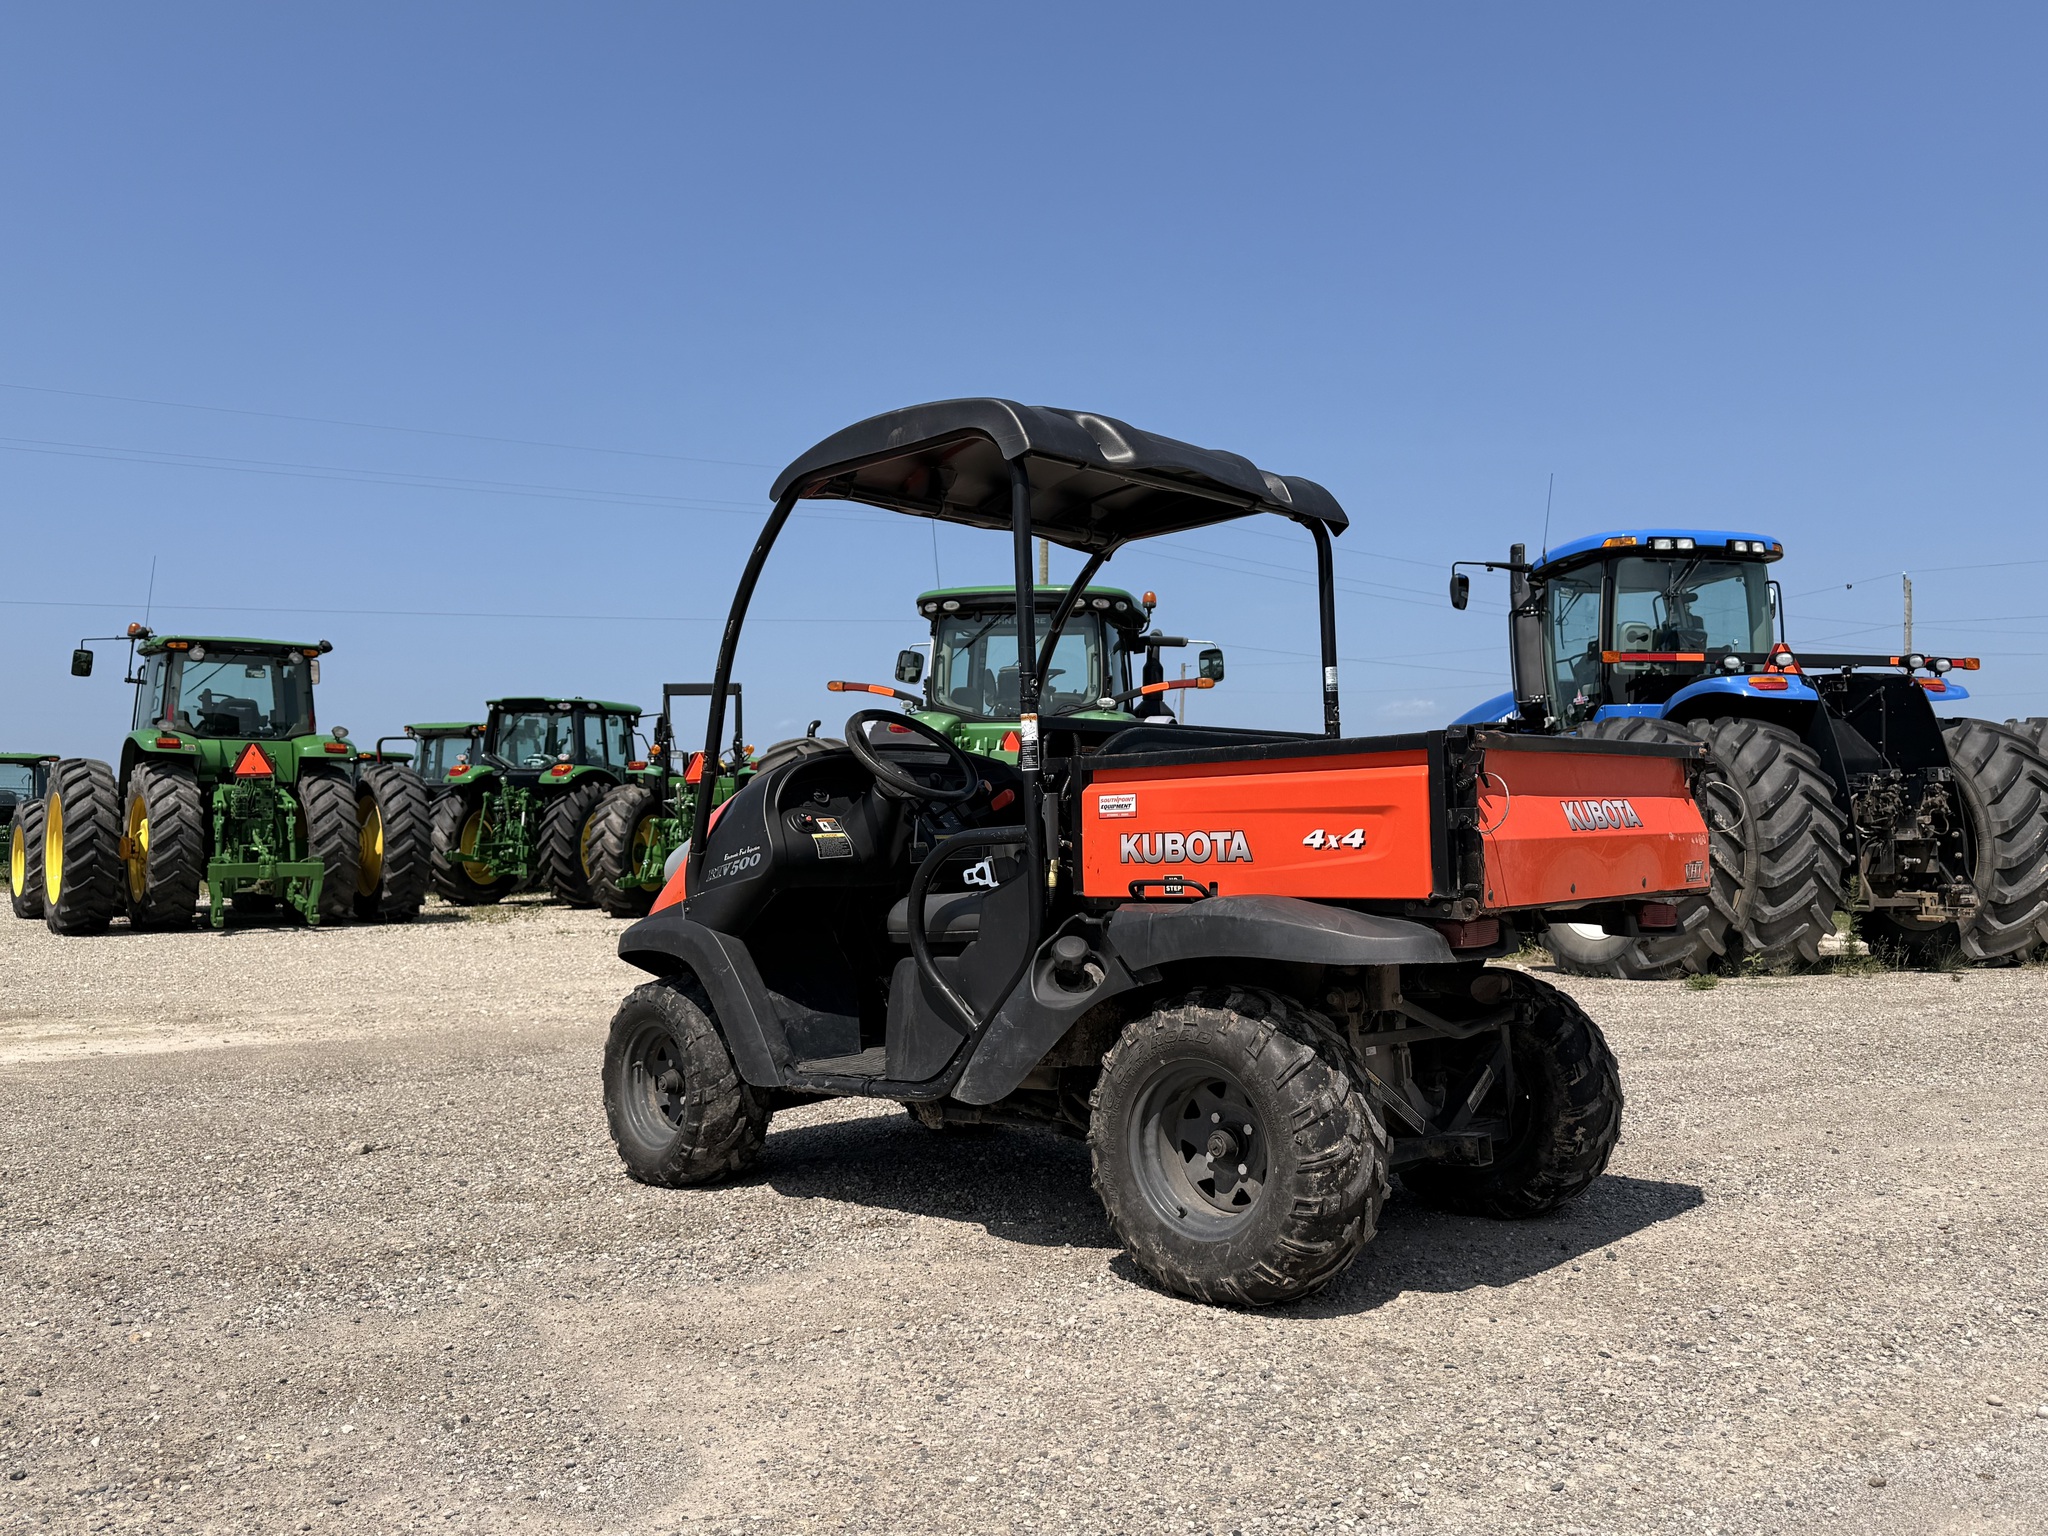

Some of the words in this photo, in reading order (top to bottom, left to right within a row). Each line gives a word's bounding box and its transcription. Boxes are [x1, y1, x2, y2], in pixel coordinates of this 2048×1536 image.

[1101, 803, 1132, 811] EQUIPMENT
[1560, 799, 1644, 832] KUBOTA
[1119, 829, 1254, 865] KUBOTA
[1302, 828, 1367, 851] 4x4
[1150, 1029, 1214, 1050] ROAD
